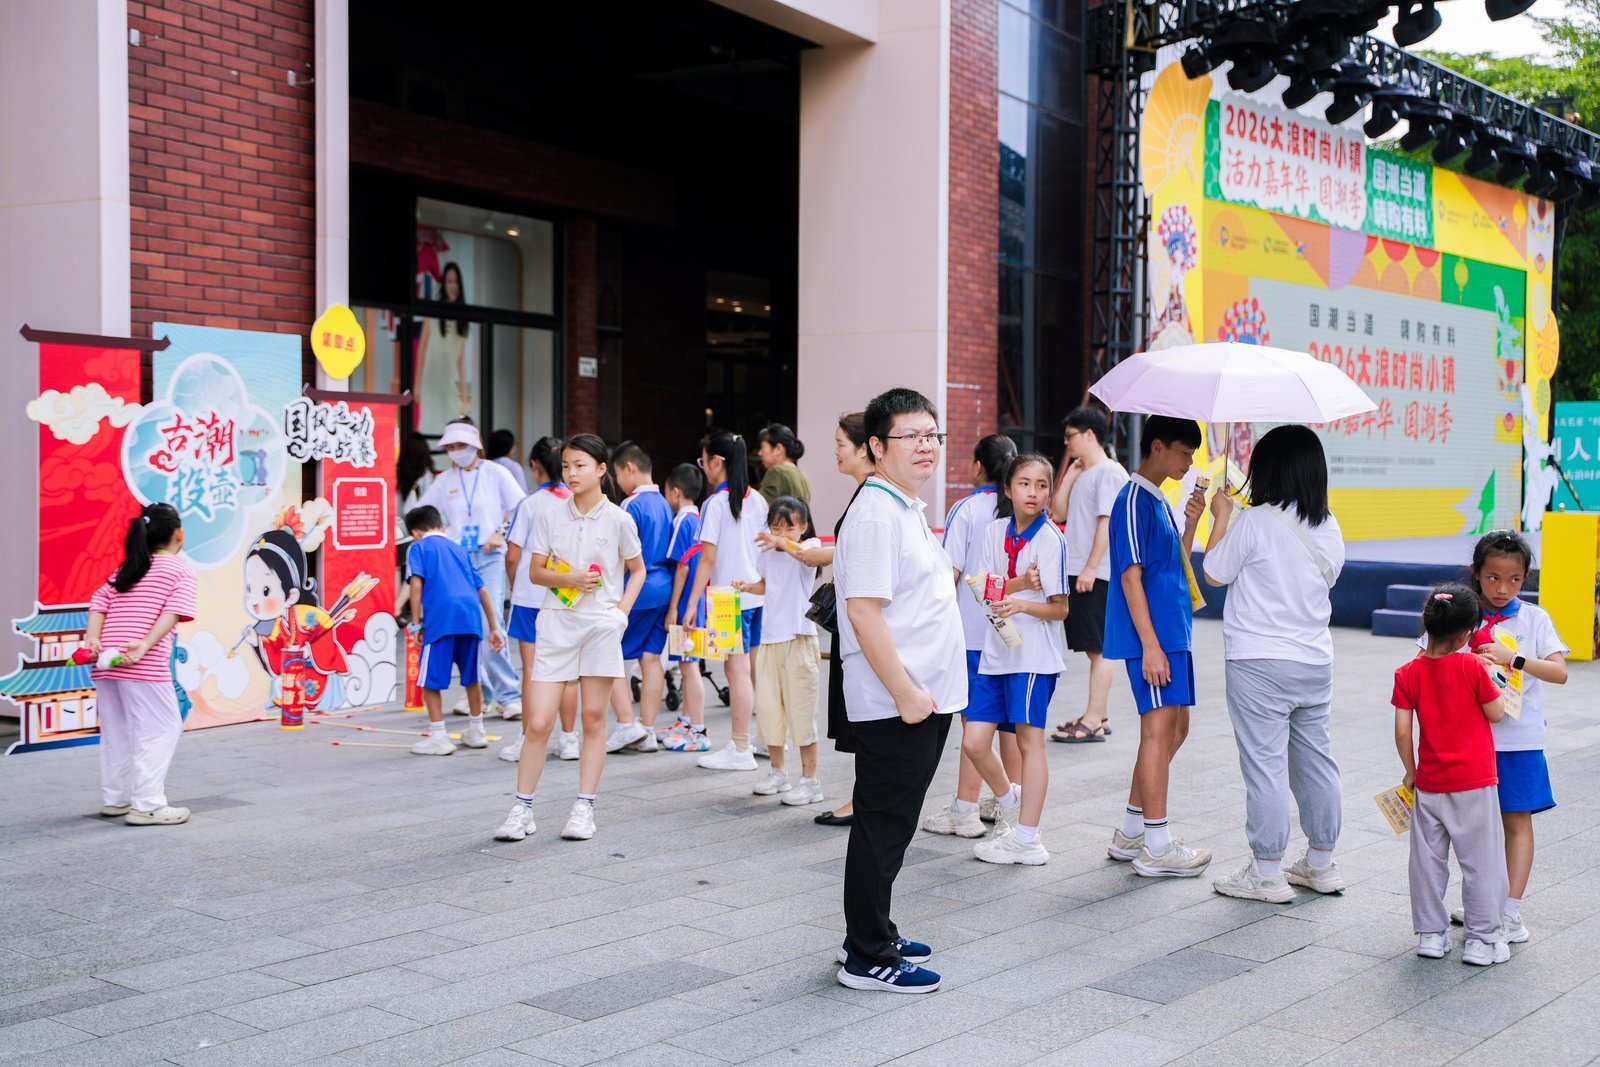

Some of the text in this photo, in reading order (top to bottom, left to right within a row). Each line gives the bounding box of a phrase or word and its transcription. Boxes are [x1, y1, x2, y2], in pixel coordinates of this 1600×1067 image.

[1226, 104, 1361, 175] 2026大浪时尚小镇
[322, 331, 355, 352] 集章点
[1310, 303, 1374, 336] 国潮当道
[162, 411, 234, 466] 古潮
[285, 402, 370, 442] 国风运动
[170, 467, 236, 518] 投壶
